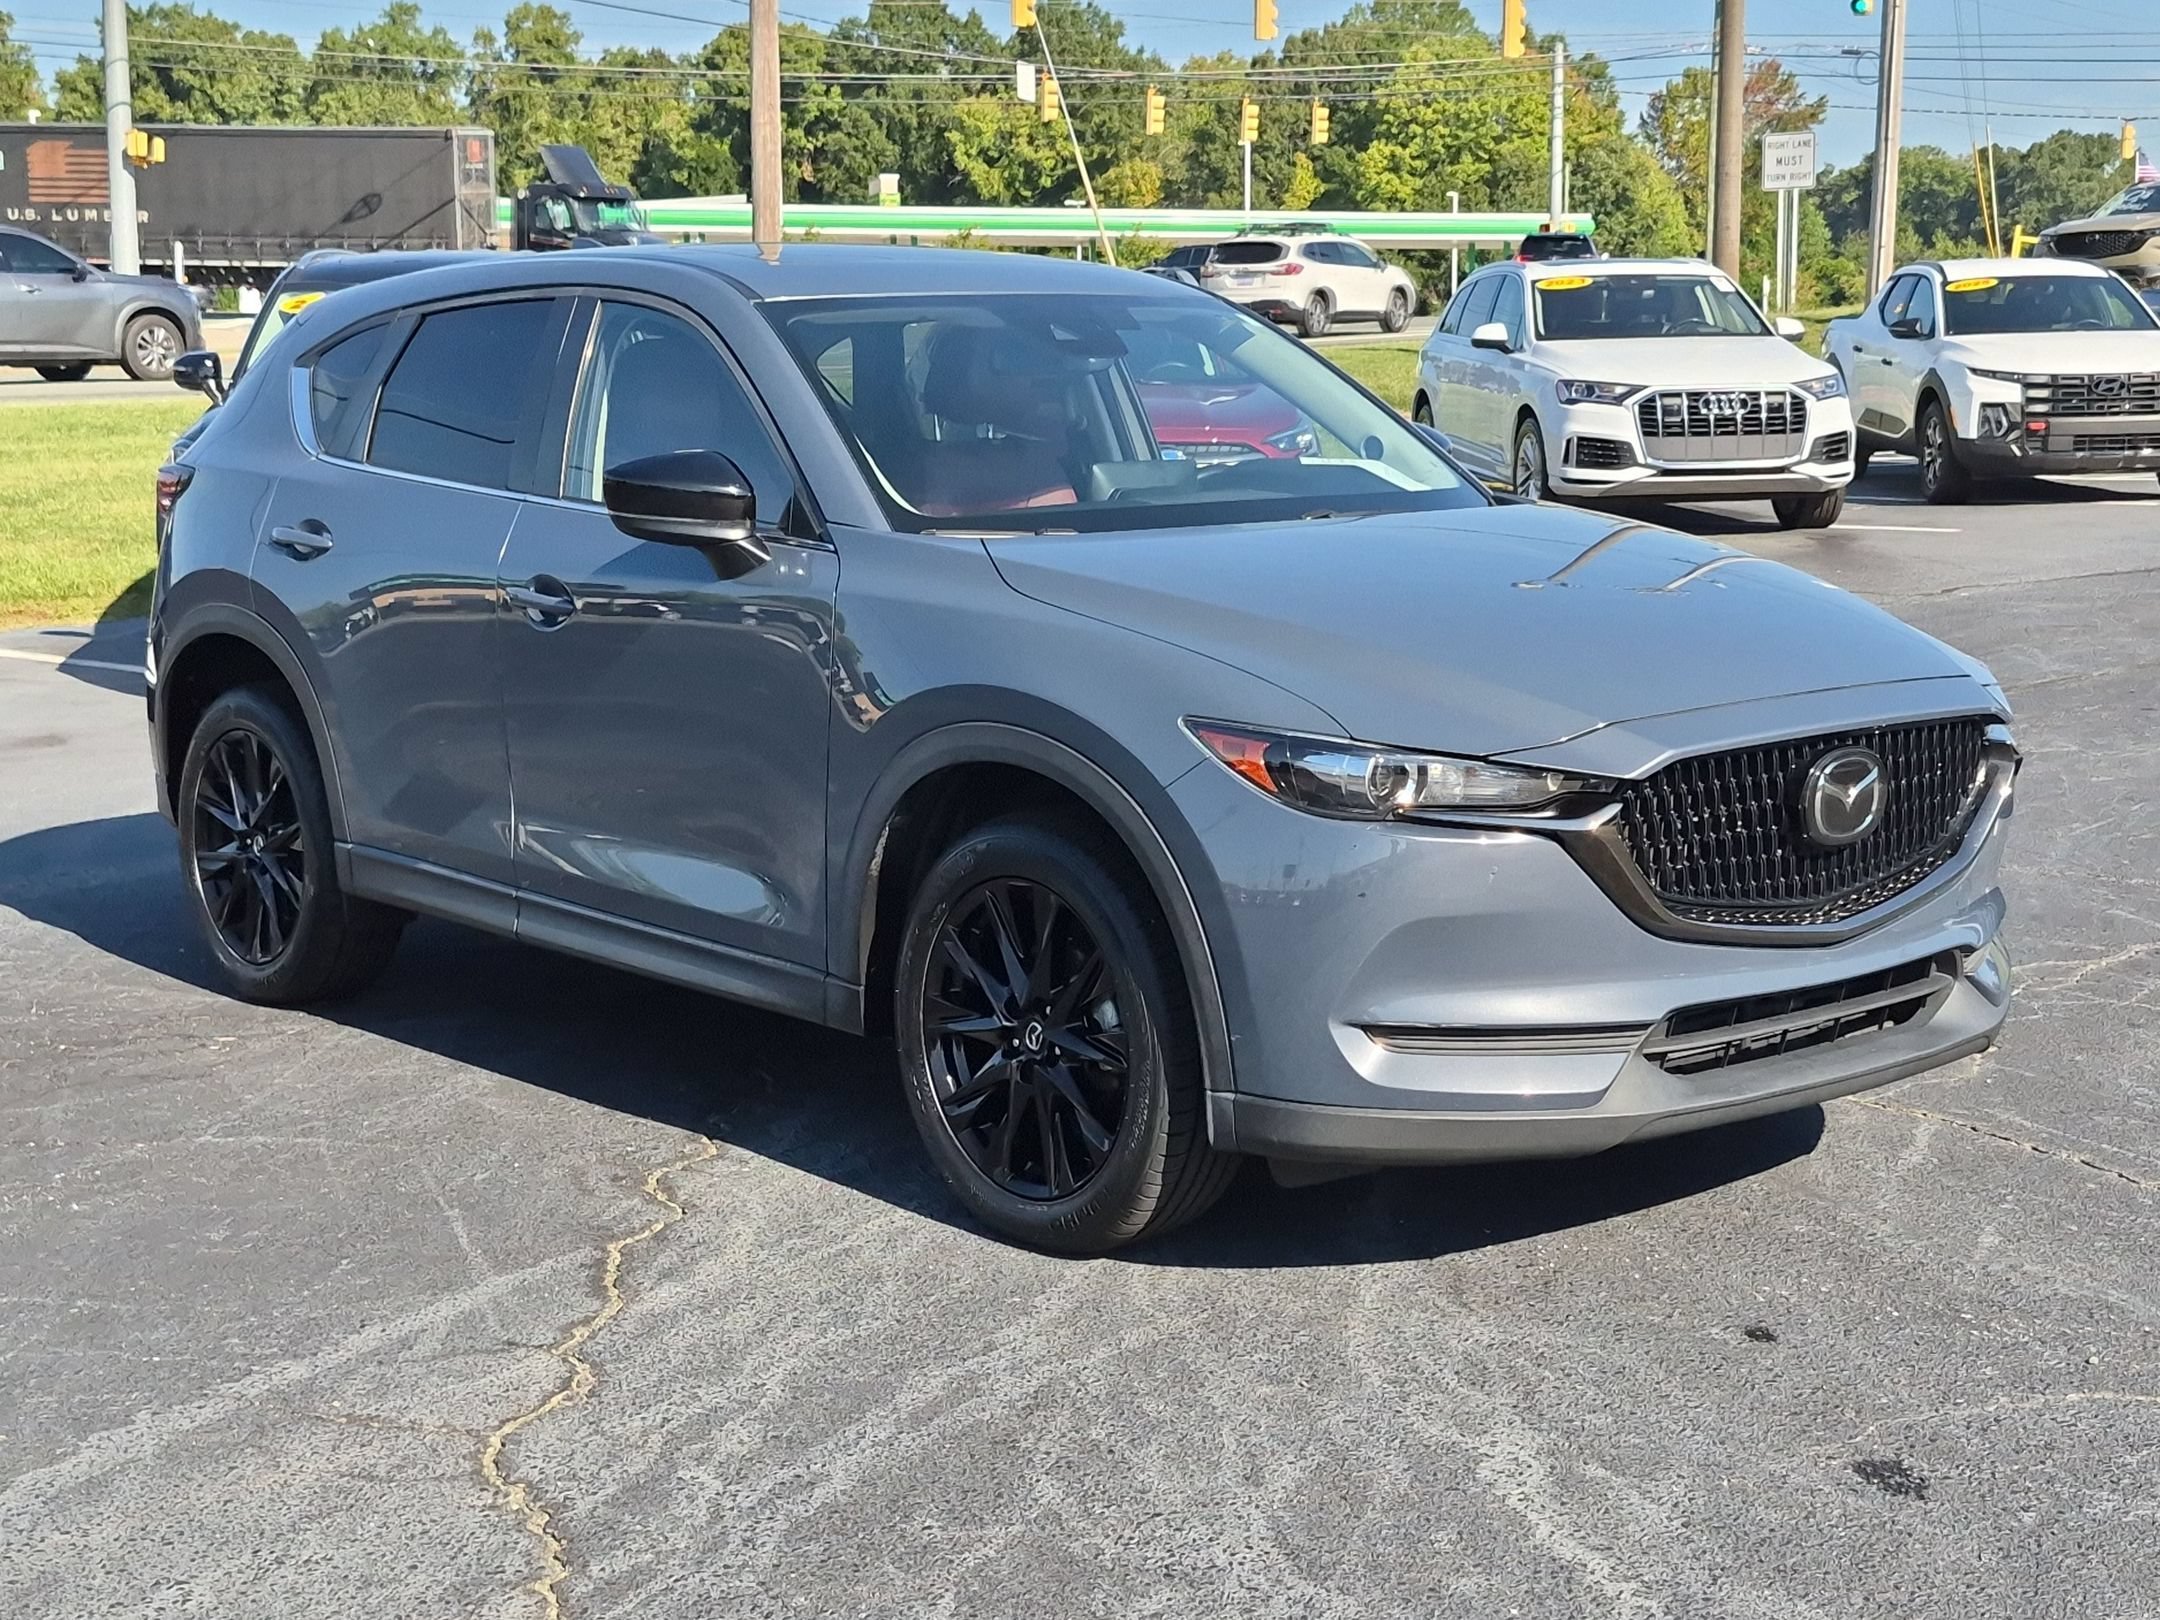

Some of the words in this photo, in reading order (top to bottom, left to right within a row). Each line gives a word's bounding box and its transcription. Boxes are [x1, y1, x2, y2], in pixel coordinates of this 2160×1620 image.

[1768, 141, 1790, 150] RIGHT
[1792, 139, 1812, 149] LANE
[1776, 155, 1803, 167] MUST
[1767, 173, 1786, 182] TURN
[1789, 171, 1811, 181] RIGHT
[51, 208, 149, 223] LUMBR
